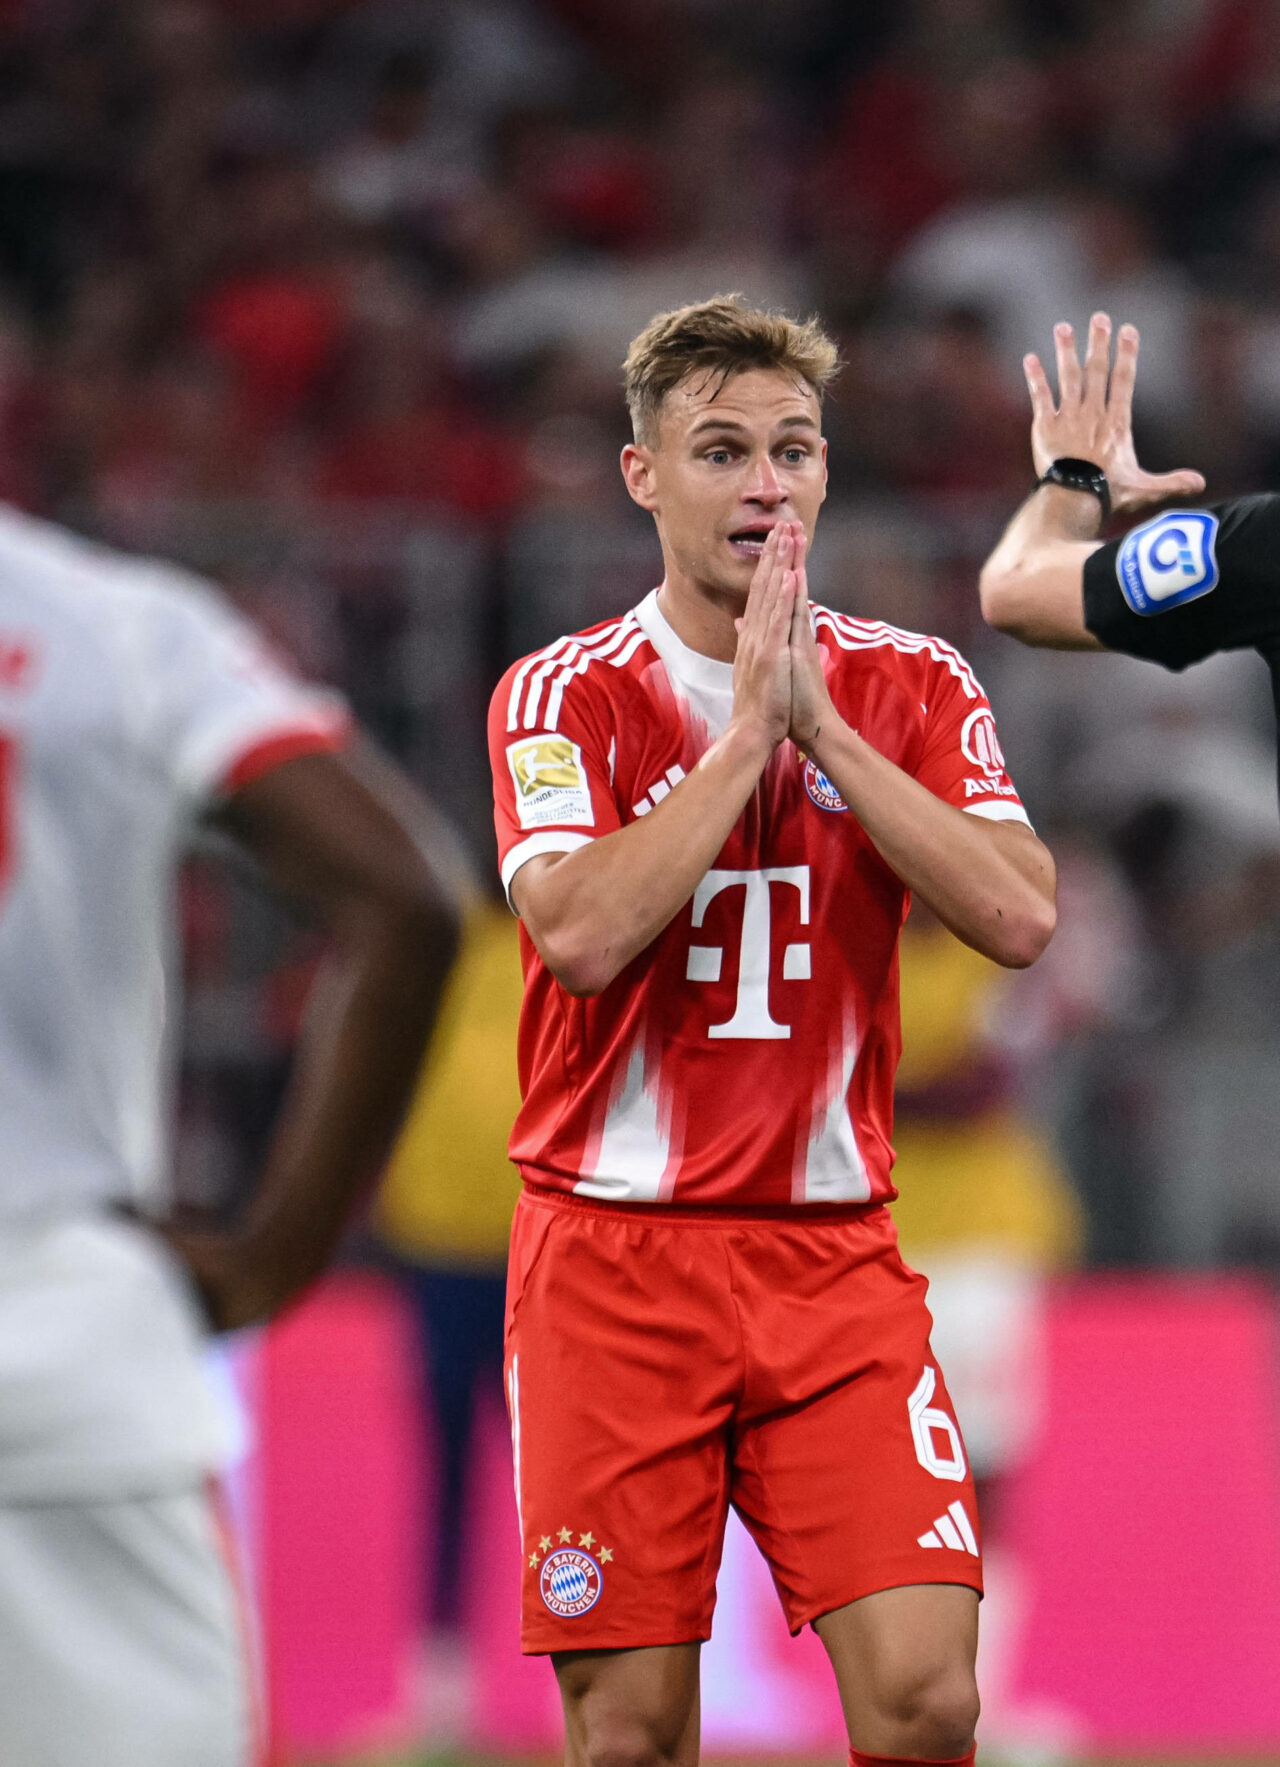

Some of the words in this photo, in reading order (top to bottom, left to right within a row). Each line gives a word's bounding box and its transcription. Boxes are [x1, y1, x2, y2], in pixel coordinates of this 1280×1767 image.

[686, 866, 811, 1039] T
[907, 1366, 966, 1482] 6
[552, 1553, 595, 1577] BAYERN
